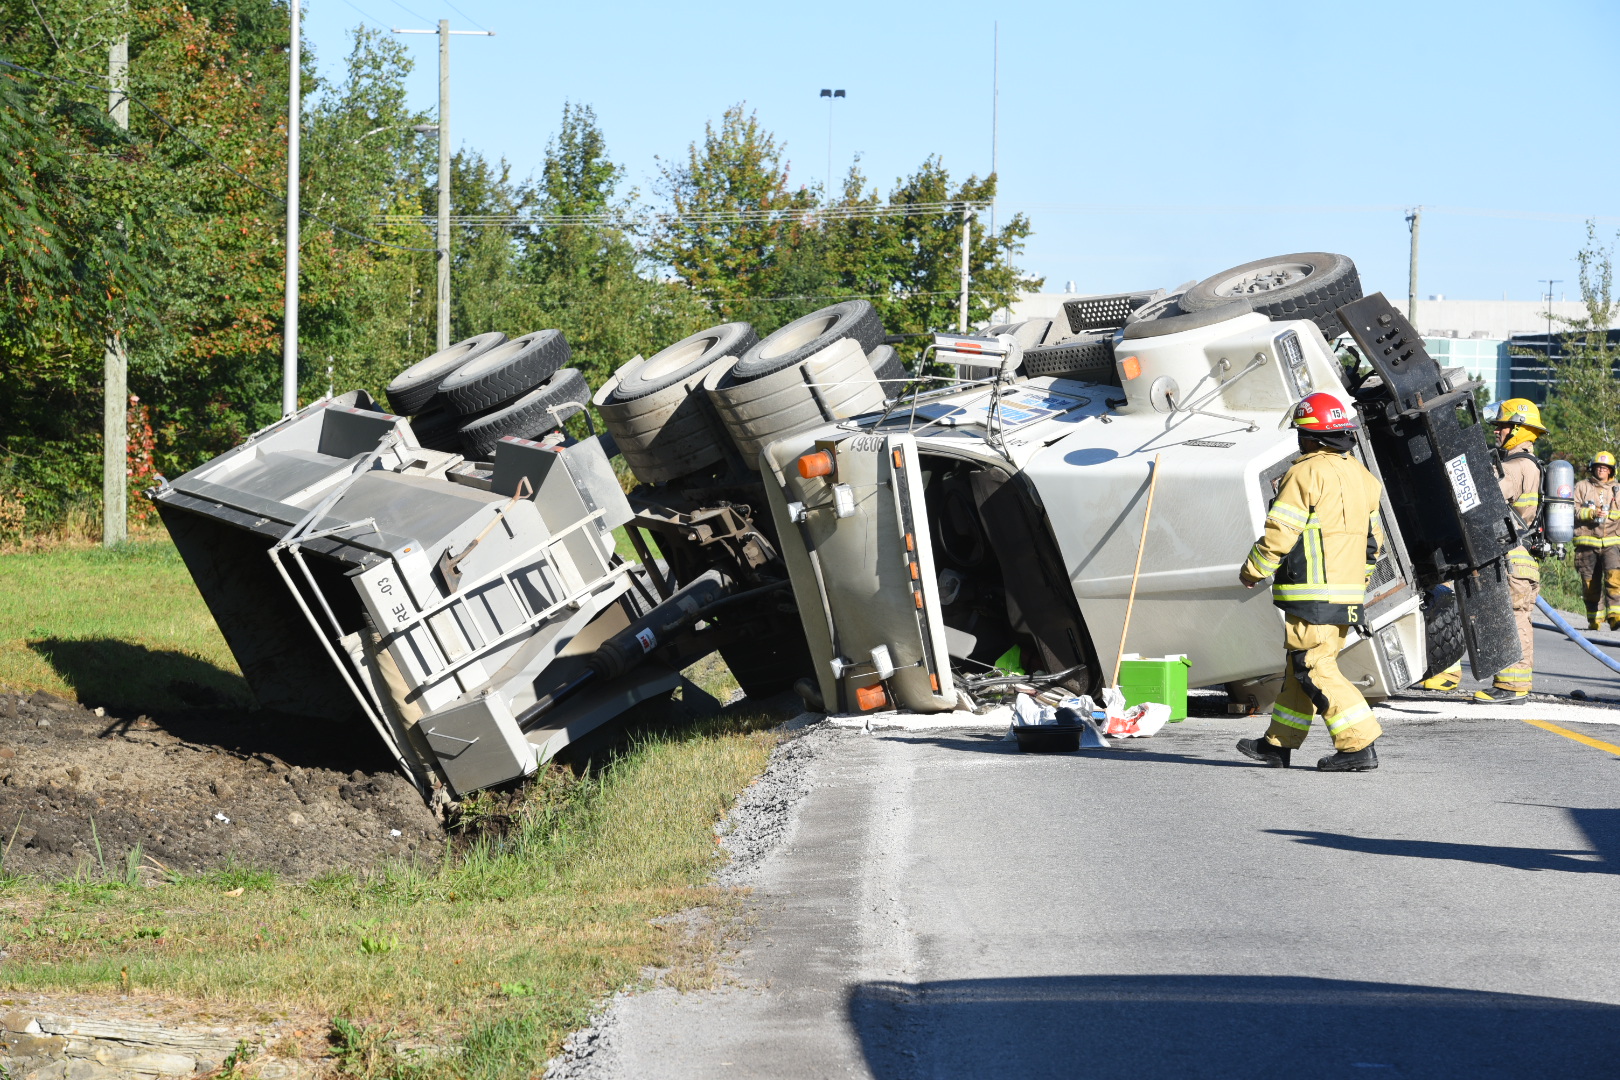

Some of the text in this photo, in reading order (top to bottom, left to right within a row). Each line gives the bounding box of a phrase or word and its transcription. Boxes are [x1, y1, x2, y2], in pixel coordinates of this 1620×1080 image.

[1332, 409, 1341, 418] 15
[1451, 459, 1475, 508] L654920
[377, 577, 410, 623] RE -03
[1347, 605, 1358, 623] 15
